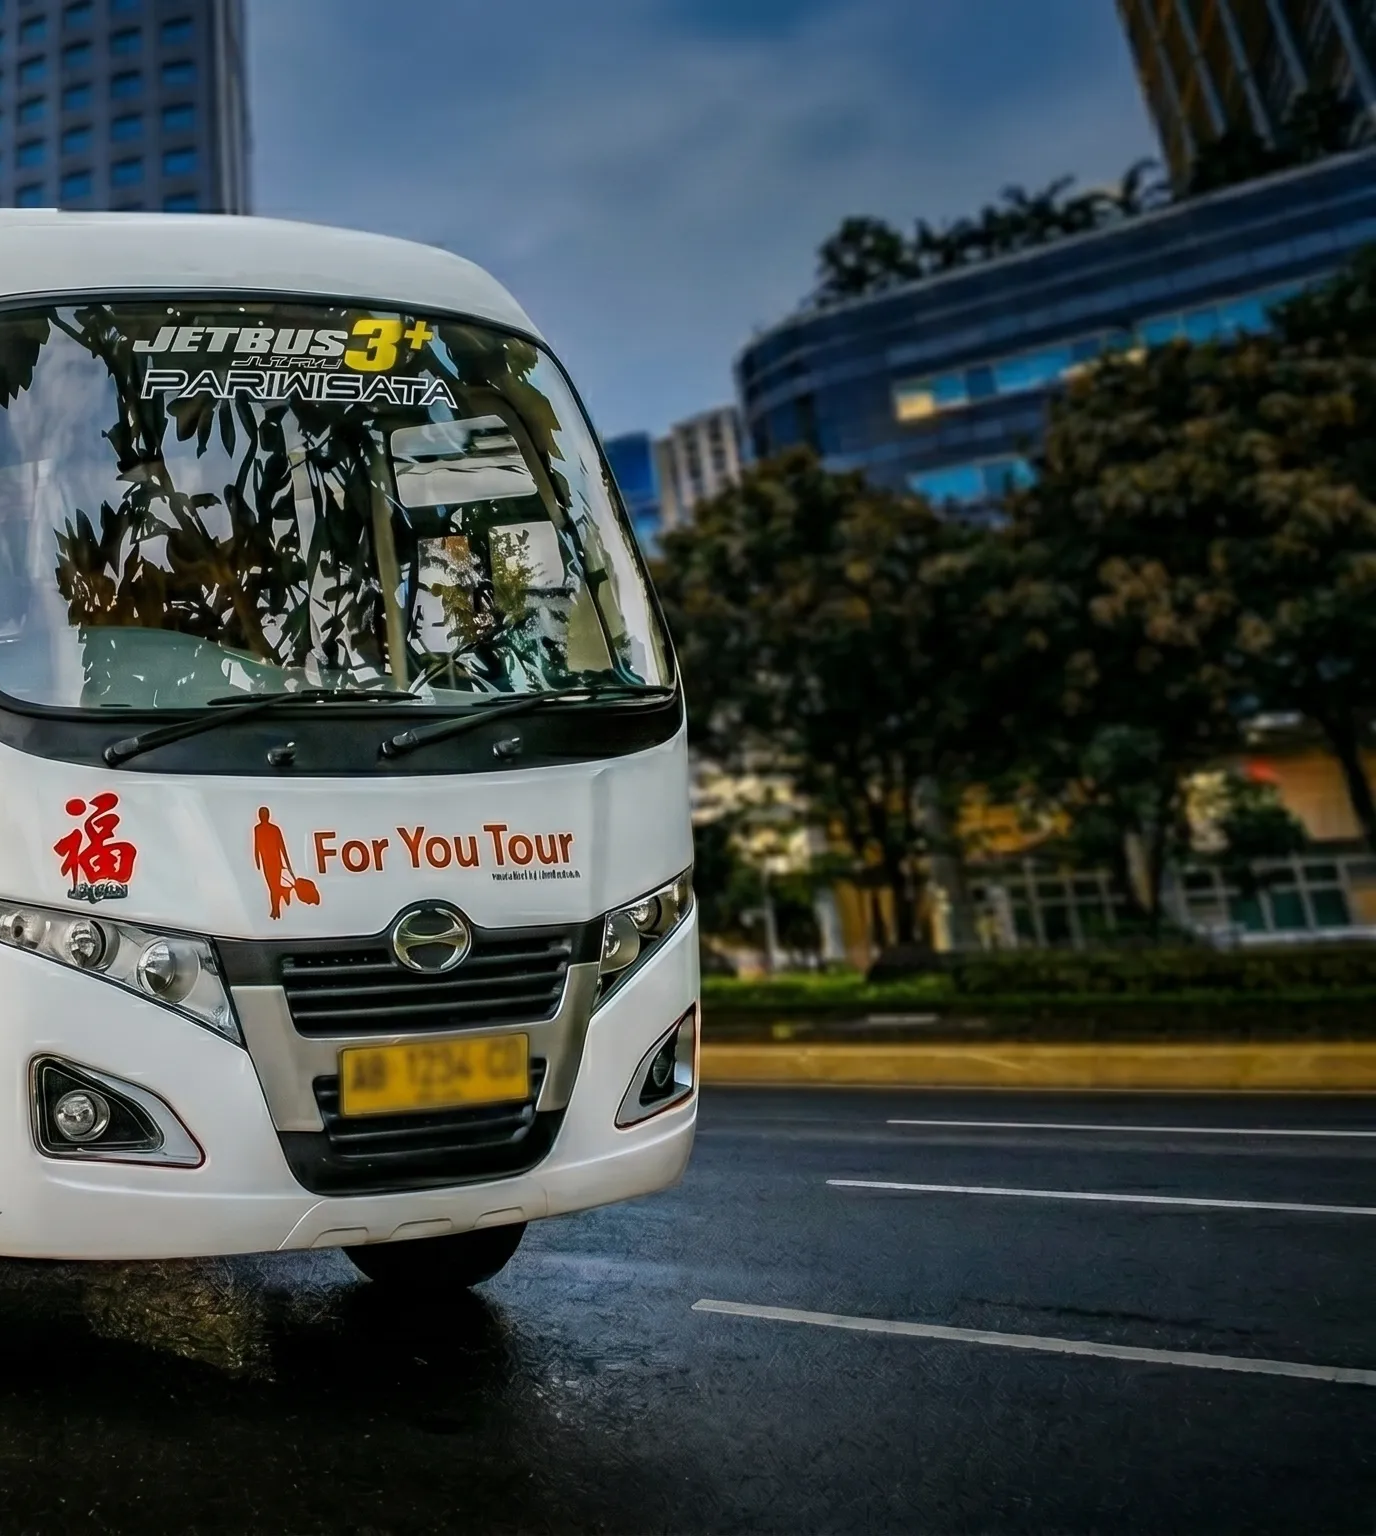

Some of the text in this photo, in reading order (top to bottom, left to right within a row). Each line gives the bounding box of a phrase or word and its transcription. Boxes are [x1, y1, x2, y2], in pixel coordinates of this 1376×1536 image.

[132, 326, 349, 356] JETBUS
[140, 368, 459, 410] PARIWISATA
[53, 792, 137, 890] 福
[313, 823, 574, 874] For You Tour
